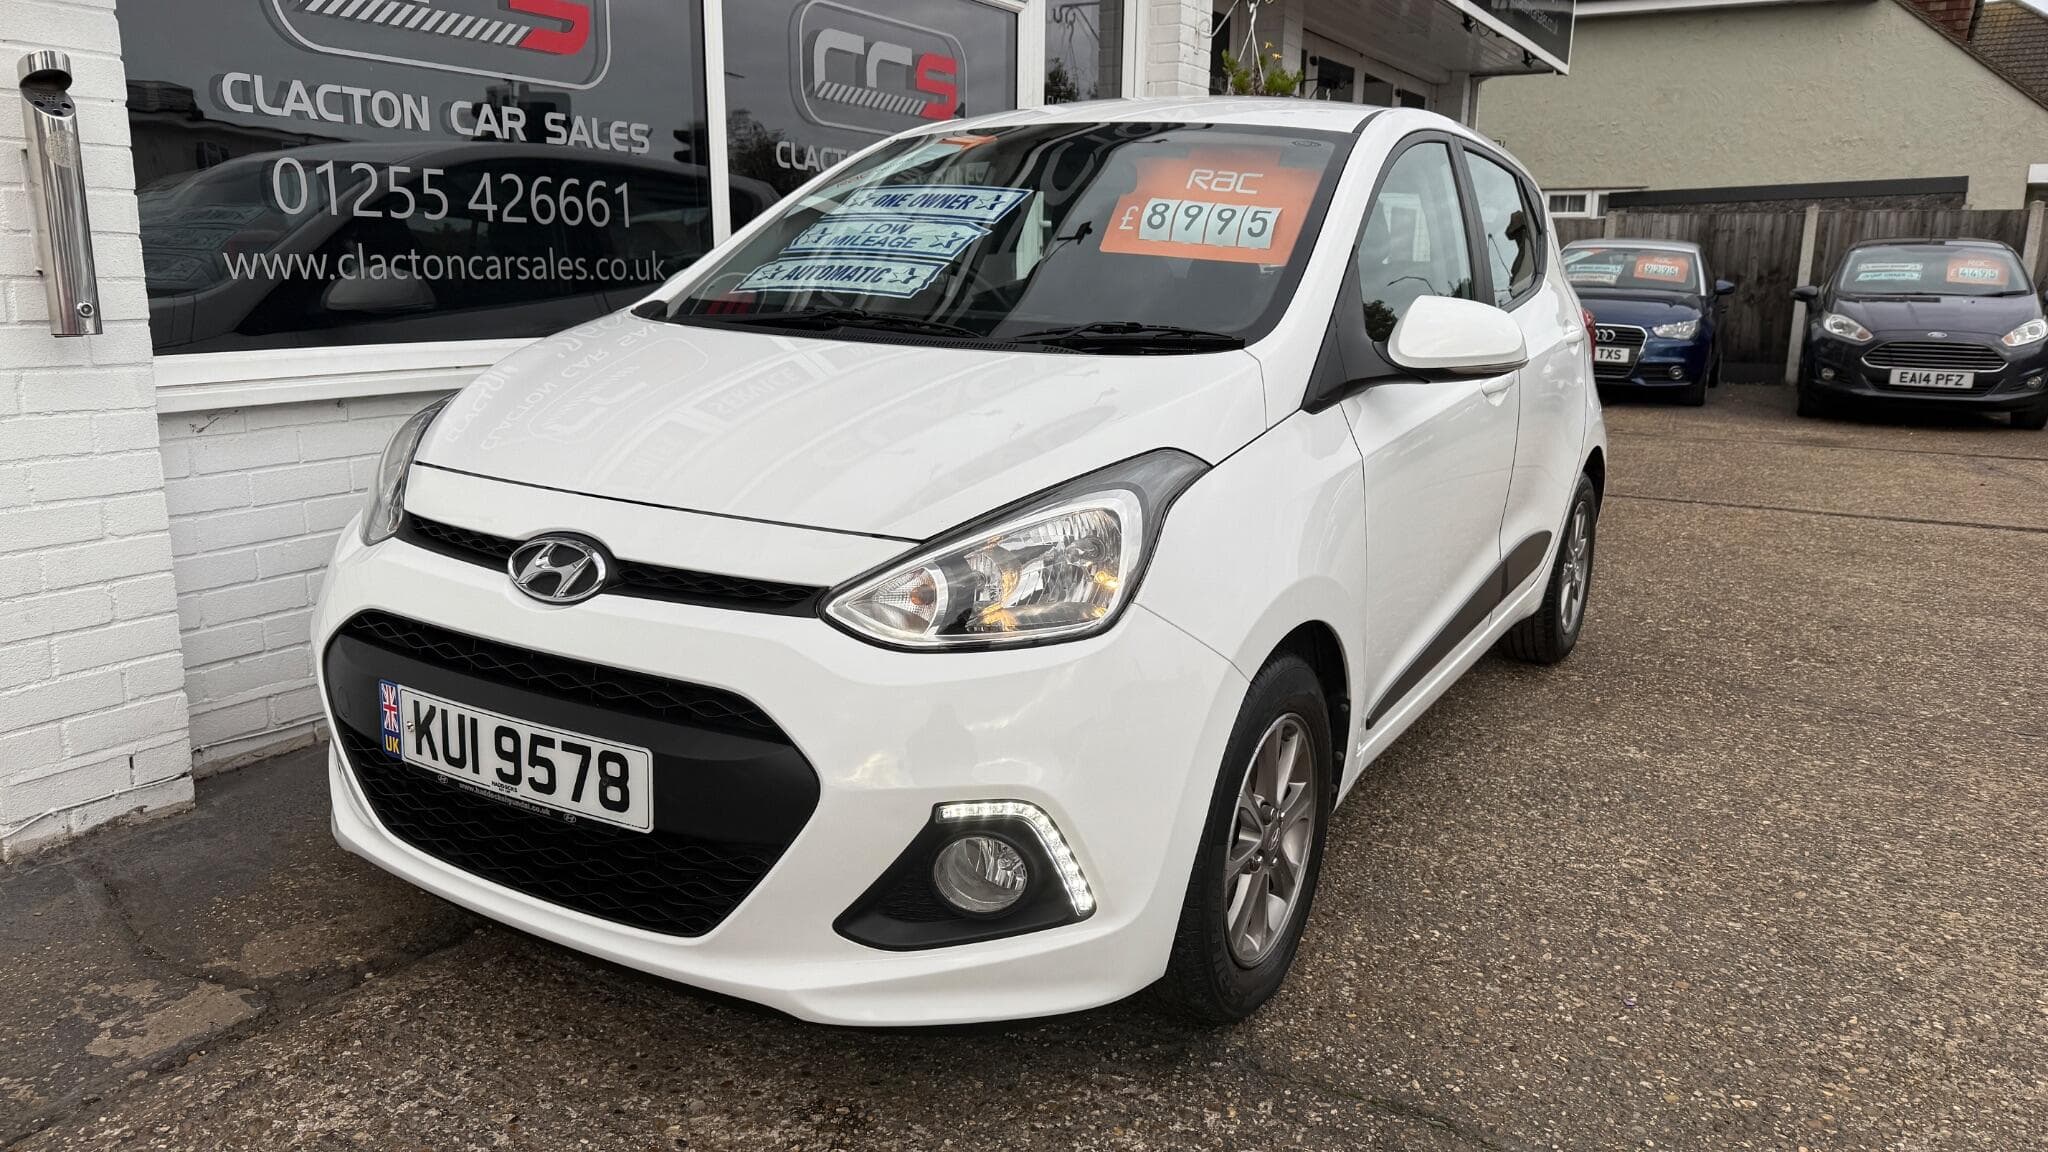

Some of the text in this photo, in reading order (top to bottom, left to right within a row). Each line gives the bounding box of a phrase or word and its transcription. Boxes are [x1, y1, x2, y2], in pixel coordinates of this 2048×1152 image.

[814, 28, 957, 120] CCS
[221, 71, 650, 154] CLACTON CAR SALES
[272, 156, 631, 229] 01255 426661
[875, 193, 978, 211] ONE OWNER
[861, 223, 914, 234] LOW
[828, 234, 922, 249] MILEAGE
[223, 244, 666, 283] www.clactoncarsales.co.uk
[781, 265, 893, 284] AUTOMATIC
[1599, 348, 1622, 360] TXS
[1899, 371, 1965, 386] EA14 PFZ
[384, 733, 400, 754] UK
[413, 700, 630, 813] KUI 9578
